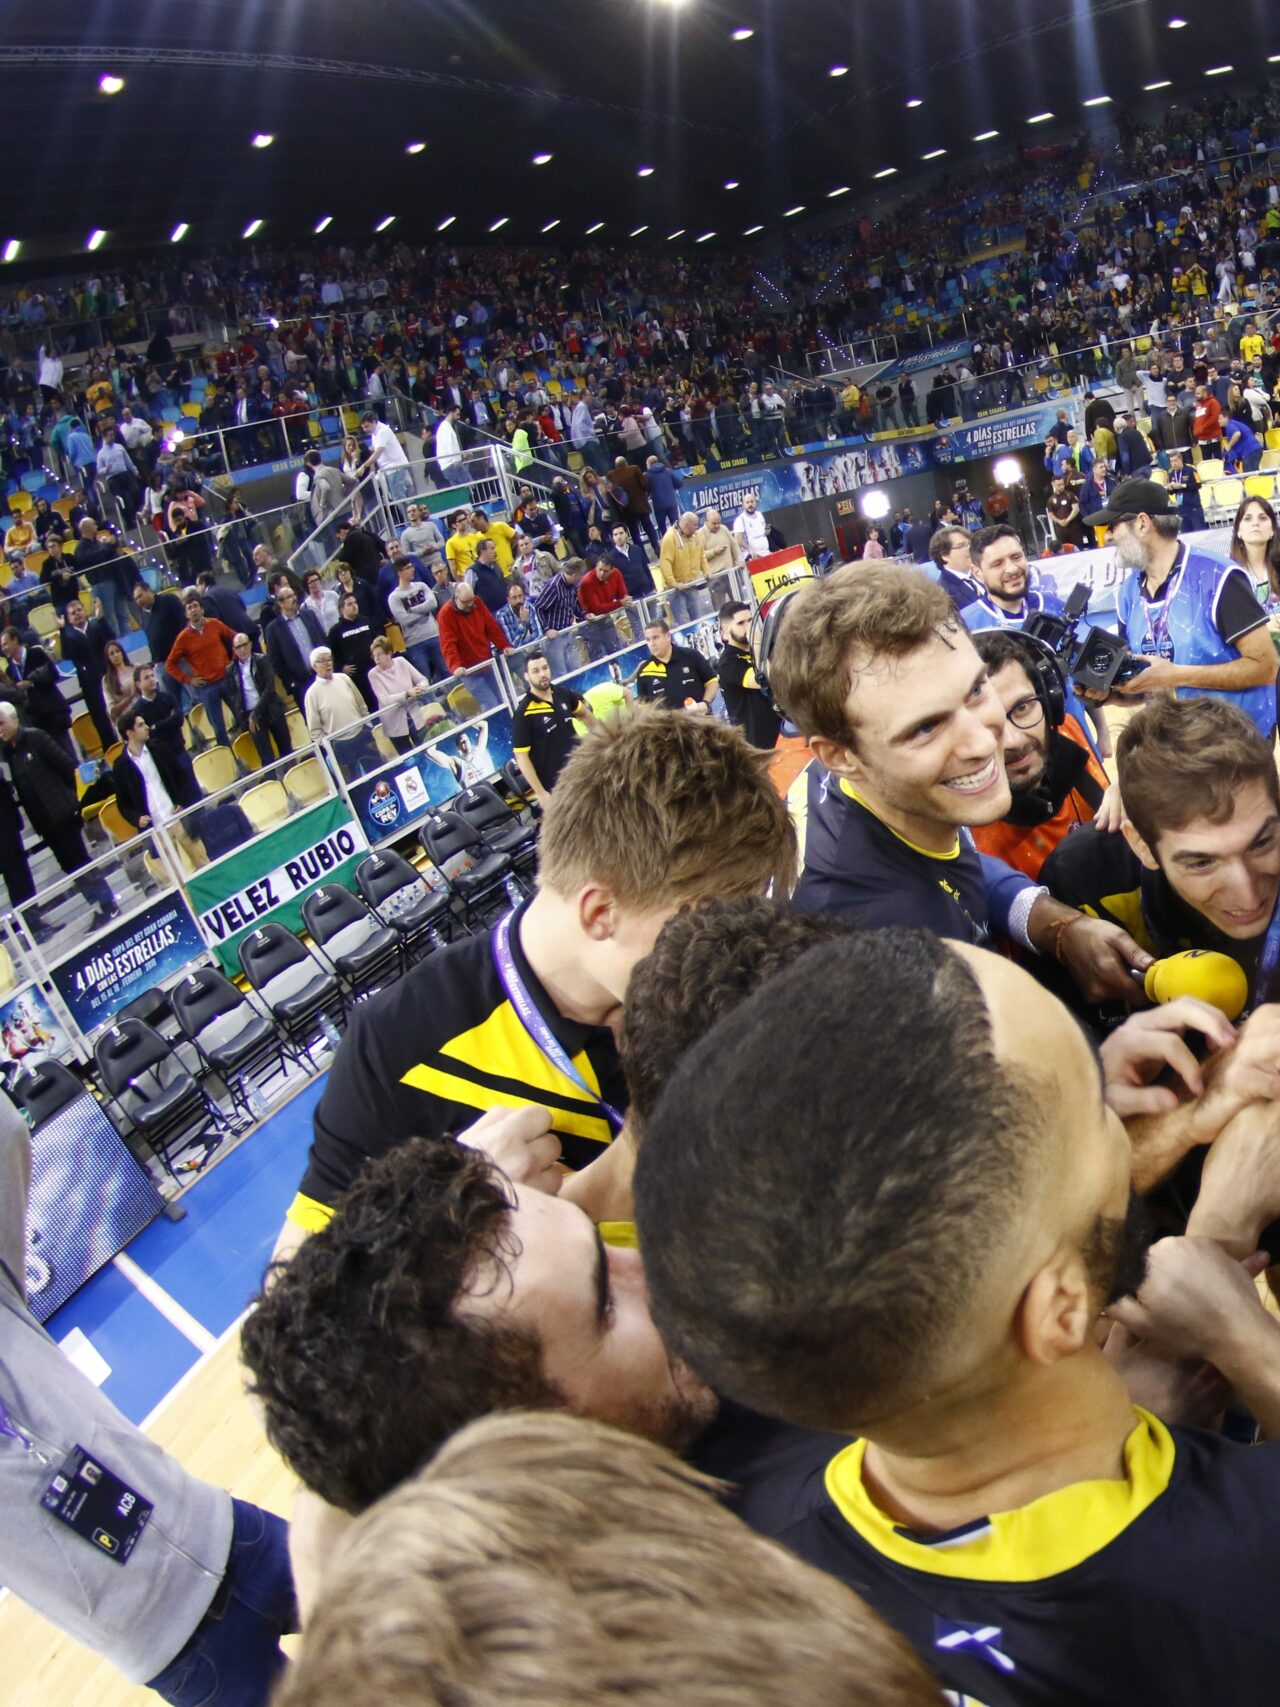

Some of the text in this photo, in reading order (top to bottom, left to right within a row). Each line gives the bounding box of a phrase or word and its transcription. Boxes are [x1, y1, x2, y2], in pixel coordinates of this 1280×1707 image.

[966, 427, 992, 444] 4 DÍAS
[993, 422, 1036, 444] ESTRELLAS
[692, 486, 719, 508] 4 DÍAS
[720, 485, 760, 510] ESTREAS
[204, 829, 355, 940] VELEZ RUBIO
[112, 943, 126, 957] COPA
[134, 930, 144, 943] REY
[114, 924, 175, 978] ESTRELLAS
[76, 952, 115, 992] 4 DÍAS
[97, 972, 119, 992] CON LAS
[117, 1492, 136, 1517] ACB
[99, 1534, 113, 1548] P
